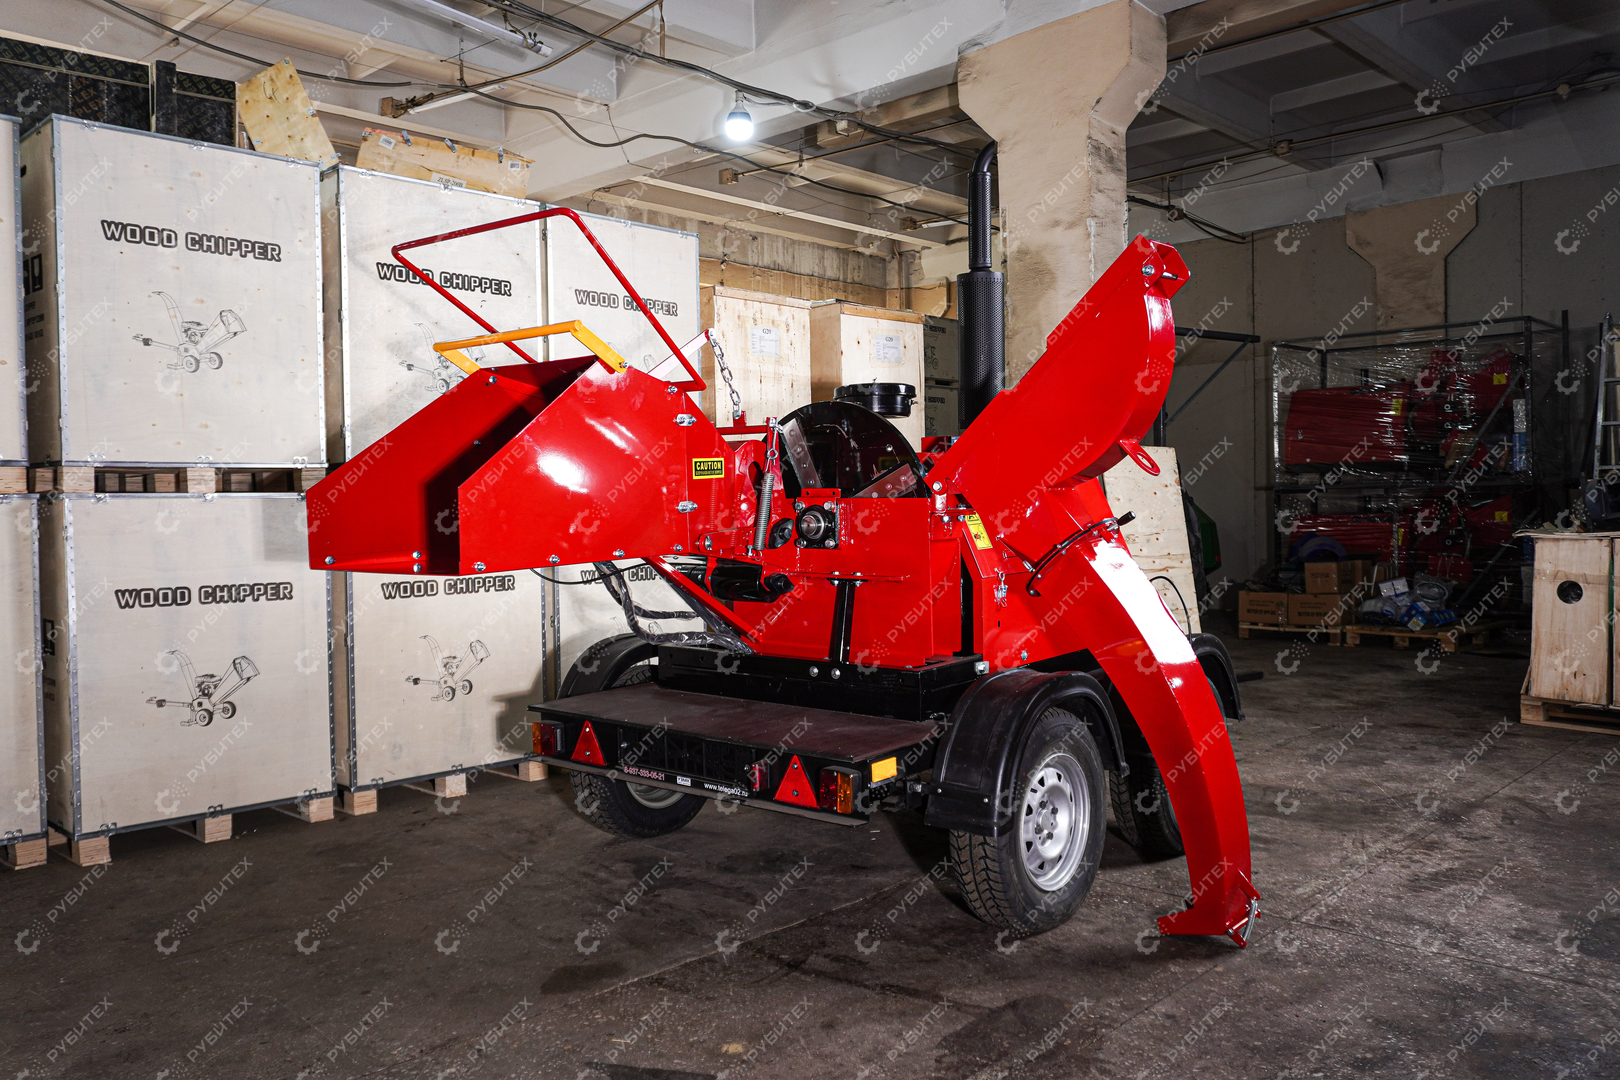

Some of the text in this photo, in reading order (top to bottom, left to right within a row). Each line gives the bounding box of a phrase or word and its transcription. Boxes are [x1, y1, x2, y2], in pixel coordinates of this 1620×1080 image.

[101, 220, 282, 263] WOOD CHIPPER
[439, 271, 512, 297] CHIPPER
[575, 289, 619, 309] WOOD
[696, 461, 722, 471] CAUTION
[114, 582, 294, 610] WOOD CHIPPER
[381, 575, 516, 600] WOOD CHIPPER
